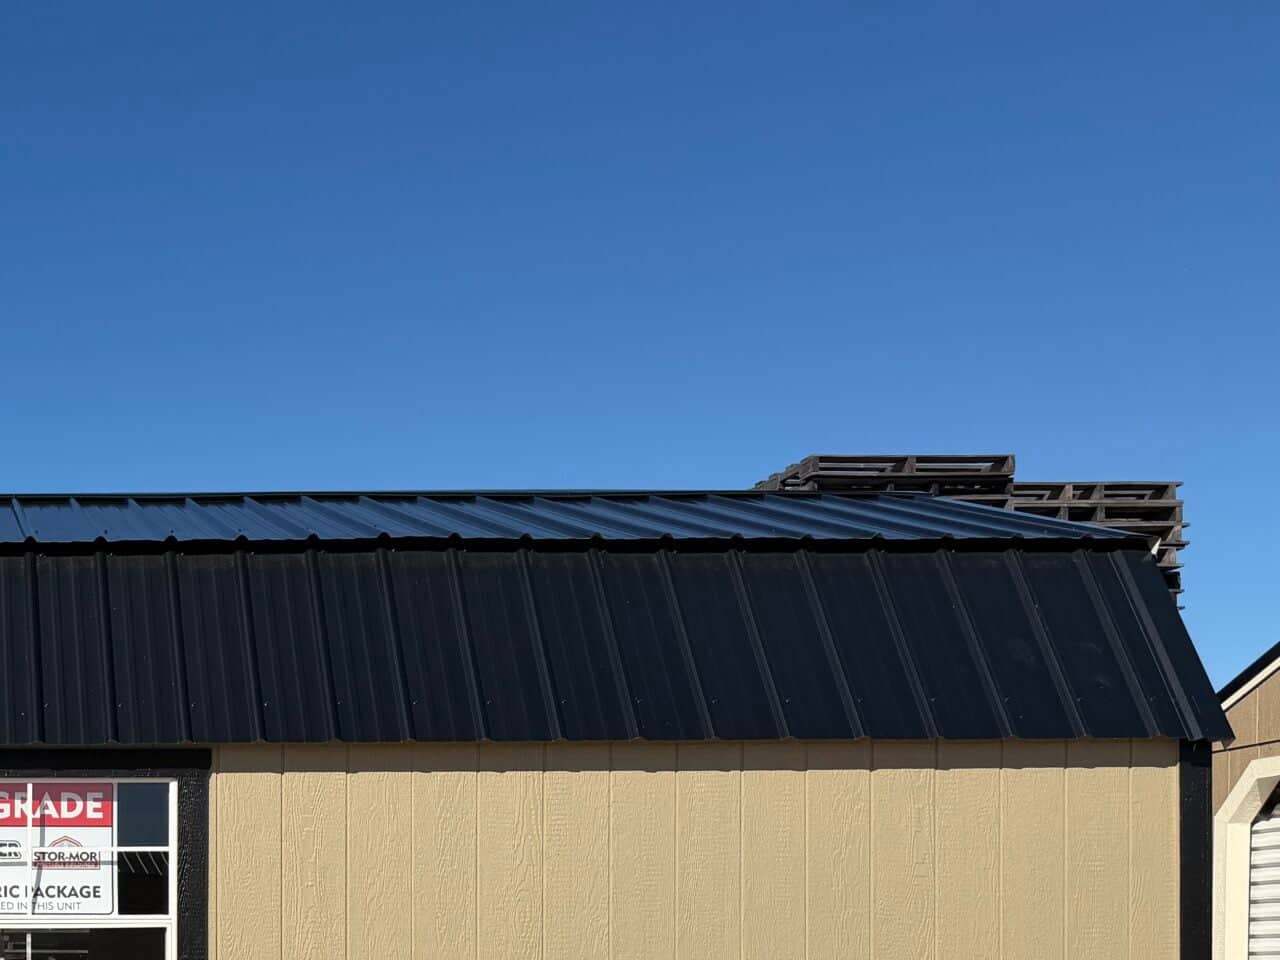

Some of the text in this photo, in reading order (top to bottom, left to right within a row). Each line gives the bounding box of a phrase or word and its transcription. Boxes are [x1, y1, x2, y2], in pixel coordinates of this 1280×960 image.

[33, 851, 98, 862] STOR-MOR
[17, 901, 28, 911] IN
[32, 901, 55, 911] THIS
[57, 901, 82, 911] UNIT
